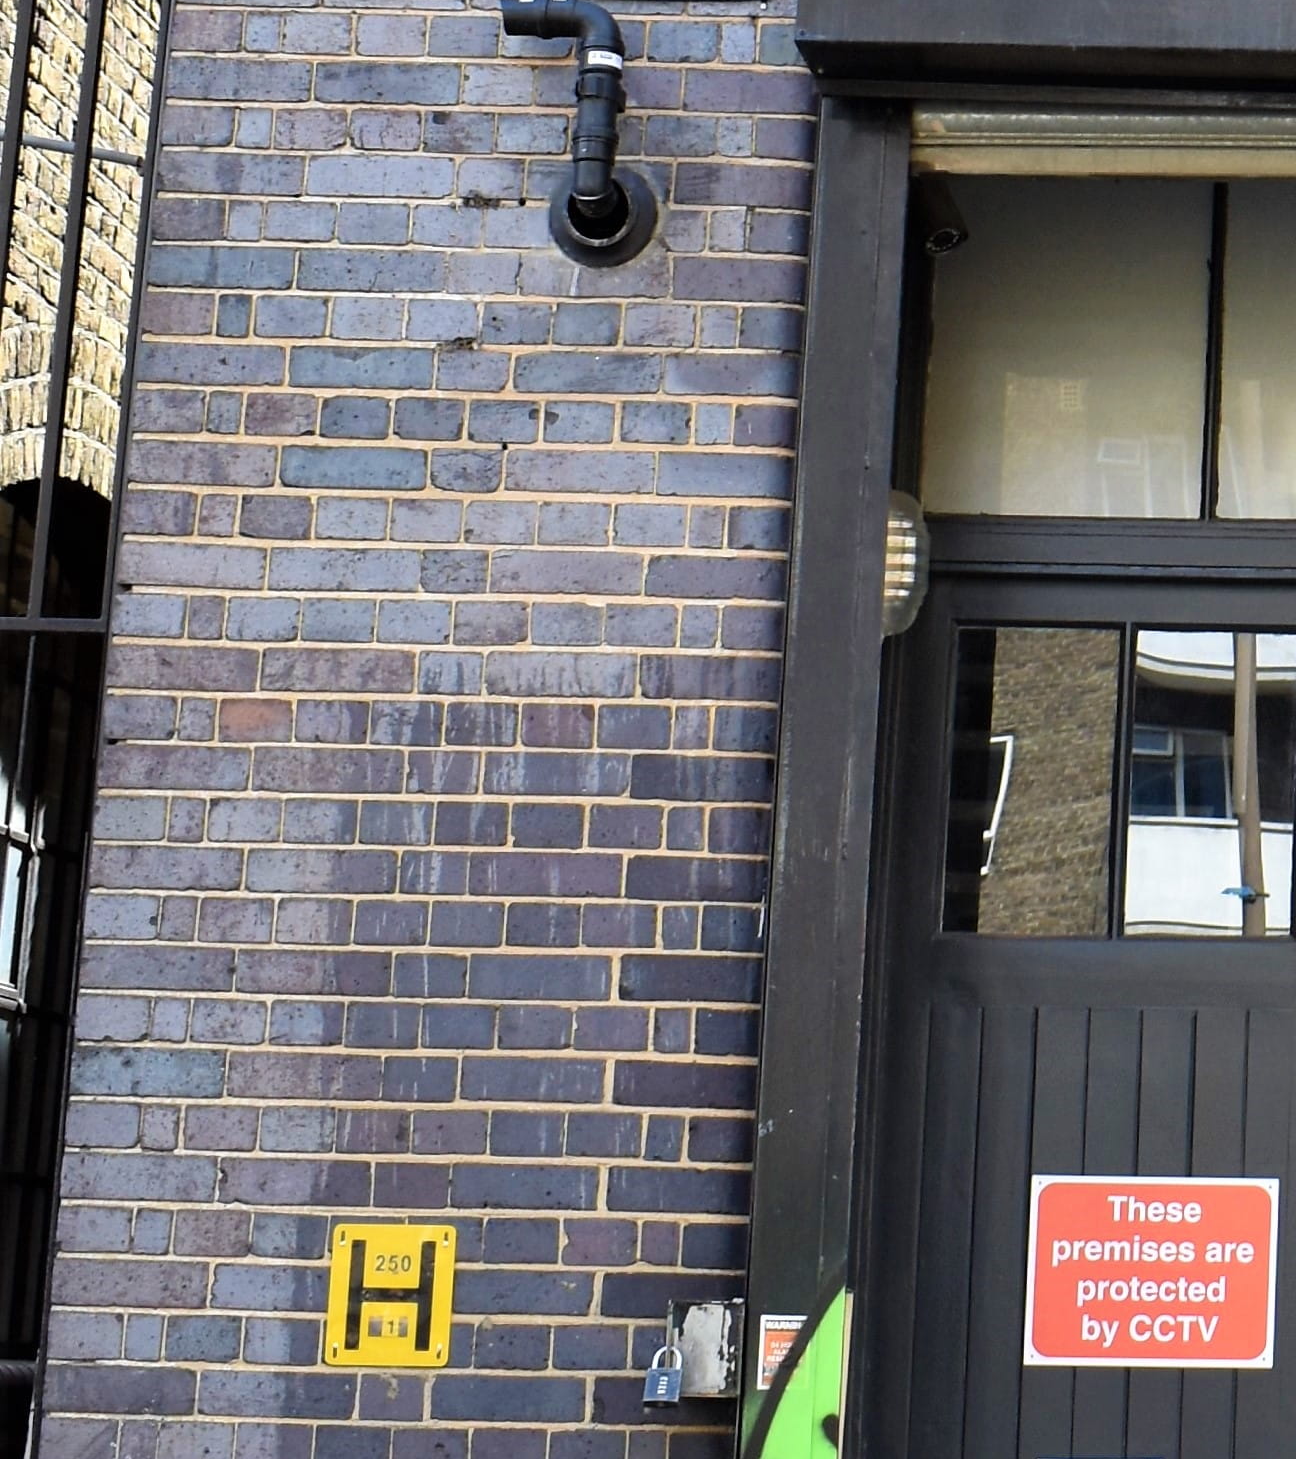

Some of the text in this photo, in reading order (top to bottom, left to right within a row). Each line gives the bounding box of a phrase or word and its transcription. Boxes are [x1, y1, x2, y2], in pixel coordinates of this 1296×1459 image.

[1107, 1195, 1202, 1223] These
[375, 1255, 411, 1272] 250
[1051, 1234, 1255, 1268] premises are
[1076, 1276, 1226, 1307] protected
[386, 1320, 394, 1334] 1
[1081, 1314, 1220, 1348] by CCTV
